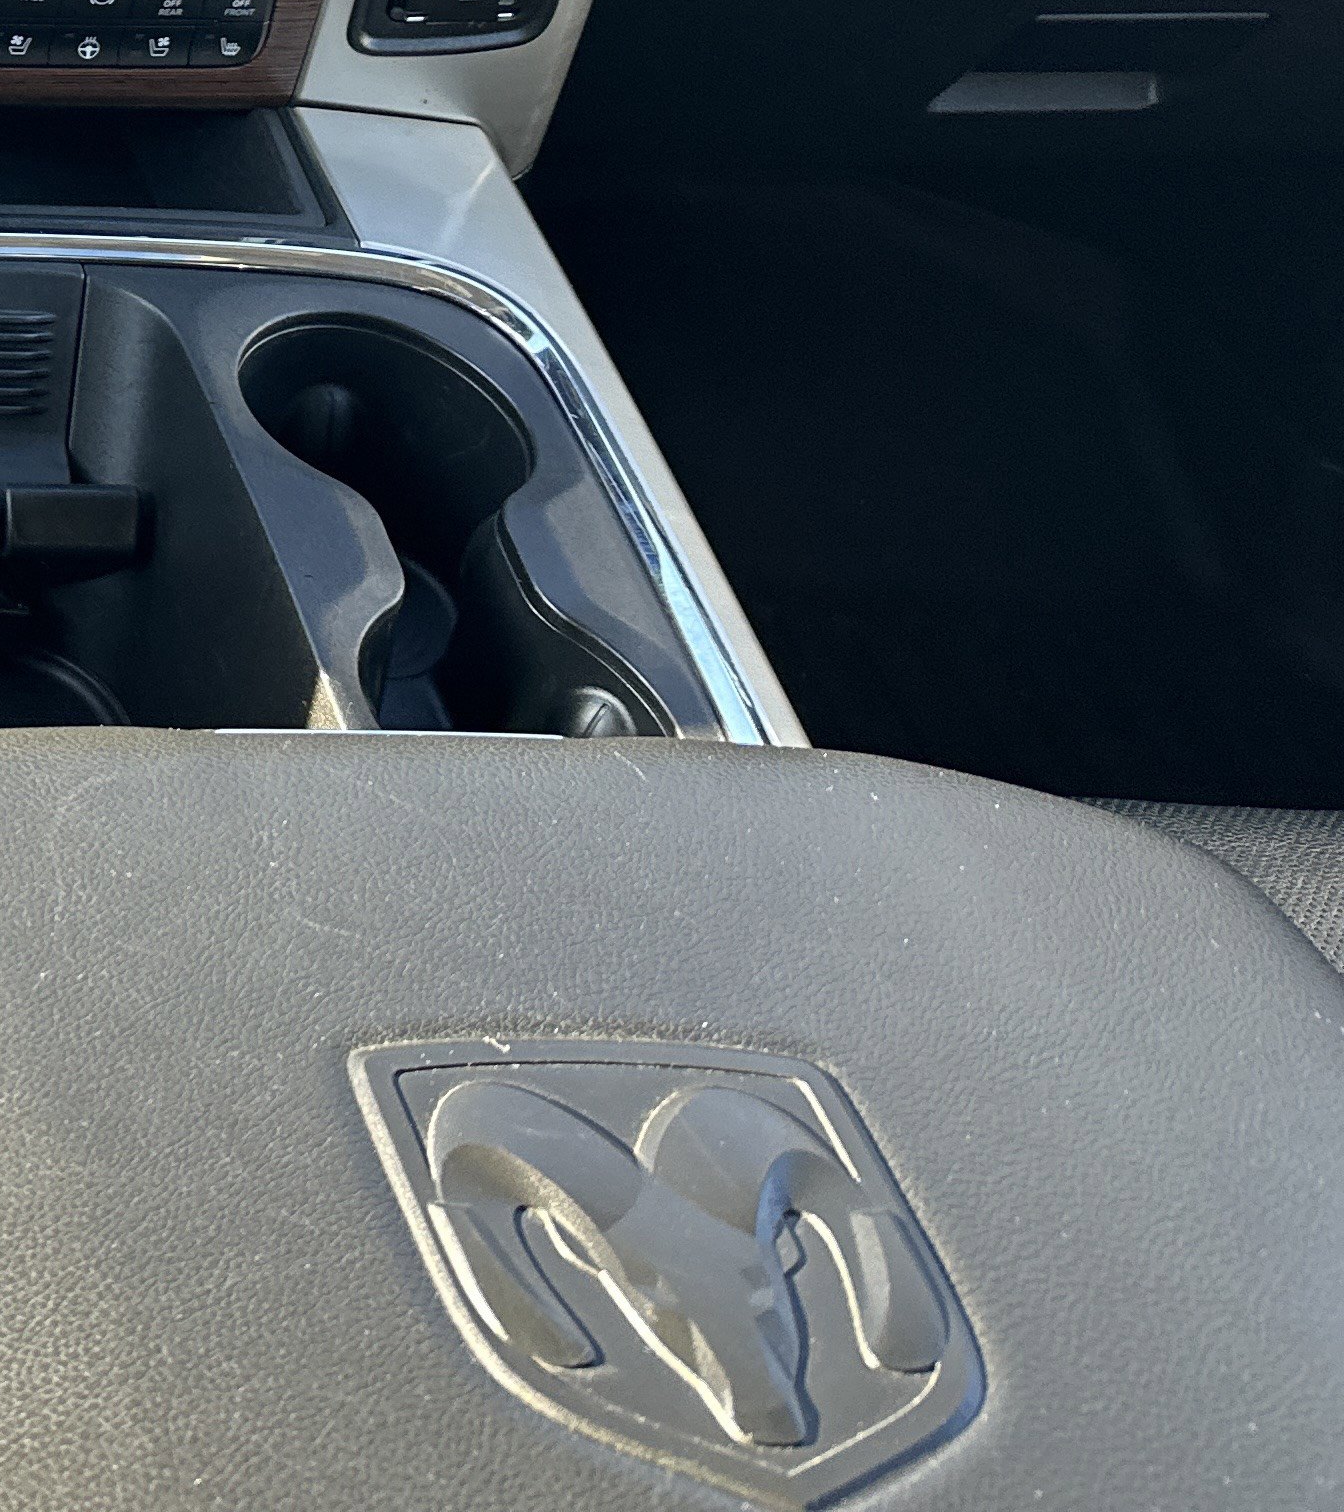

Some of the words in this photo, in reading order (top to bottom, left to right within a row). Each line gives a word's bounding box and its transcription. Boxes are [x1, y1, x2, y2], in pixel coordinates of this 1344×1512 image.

[162, 0, 182, 8] OFF
[232, 0, 251, 8] OFF
[158, 8, 183, 17] REAR
[224, 7, 256, 17] FRONT
